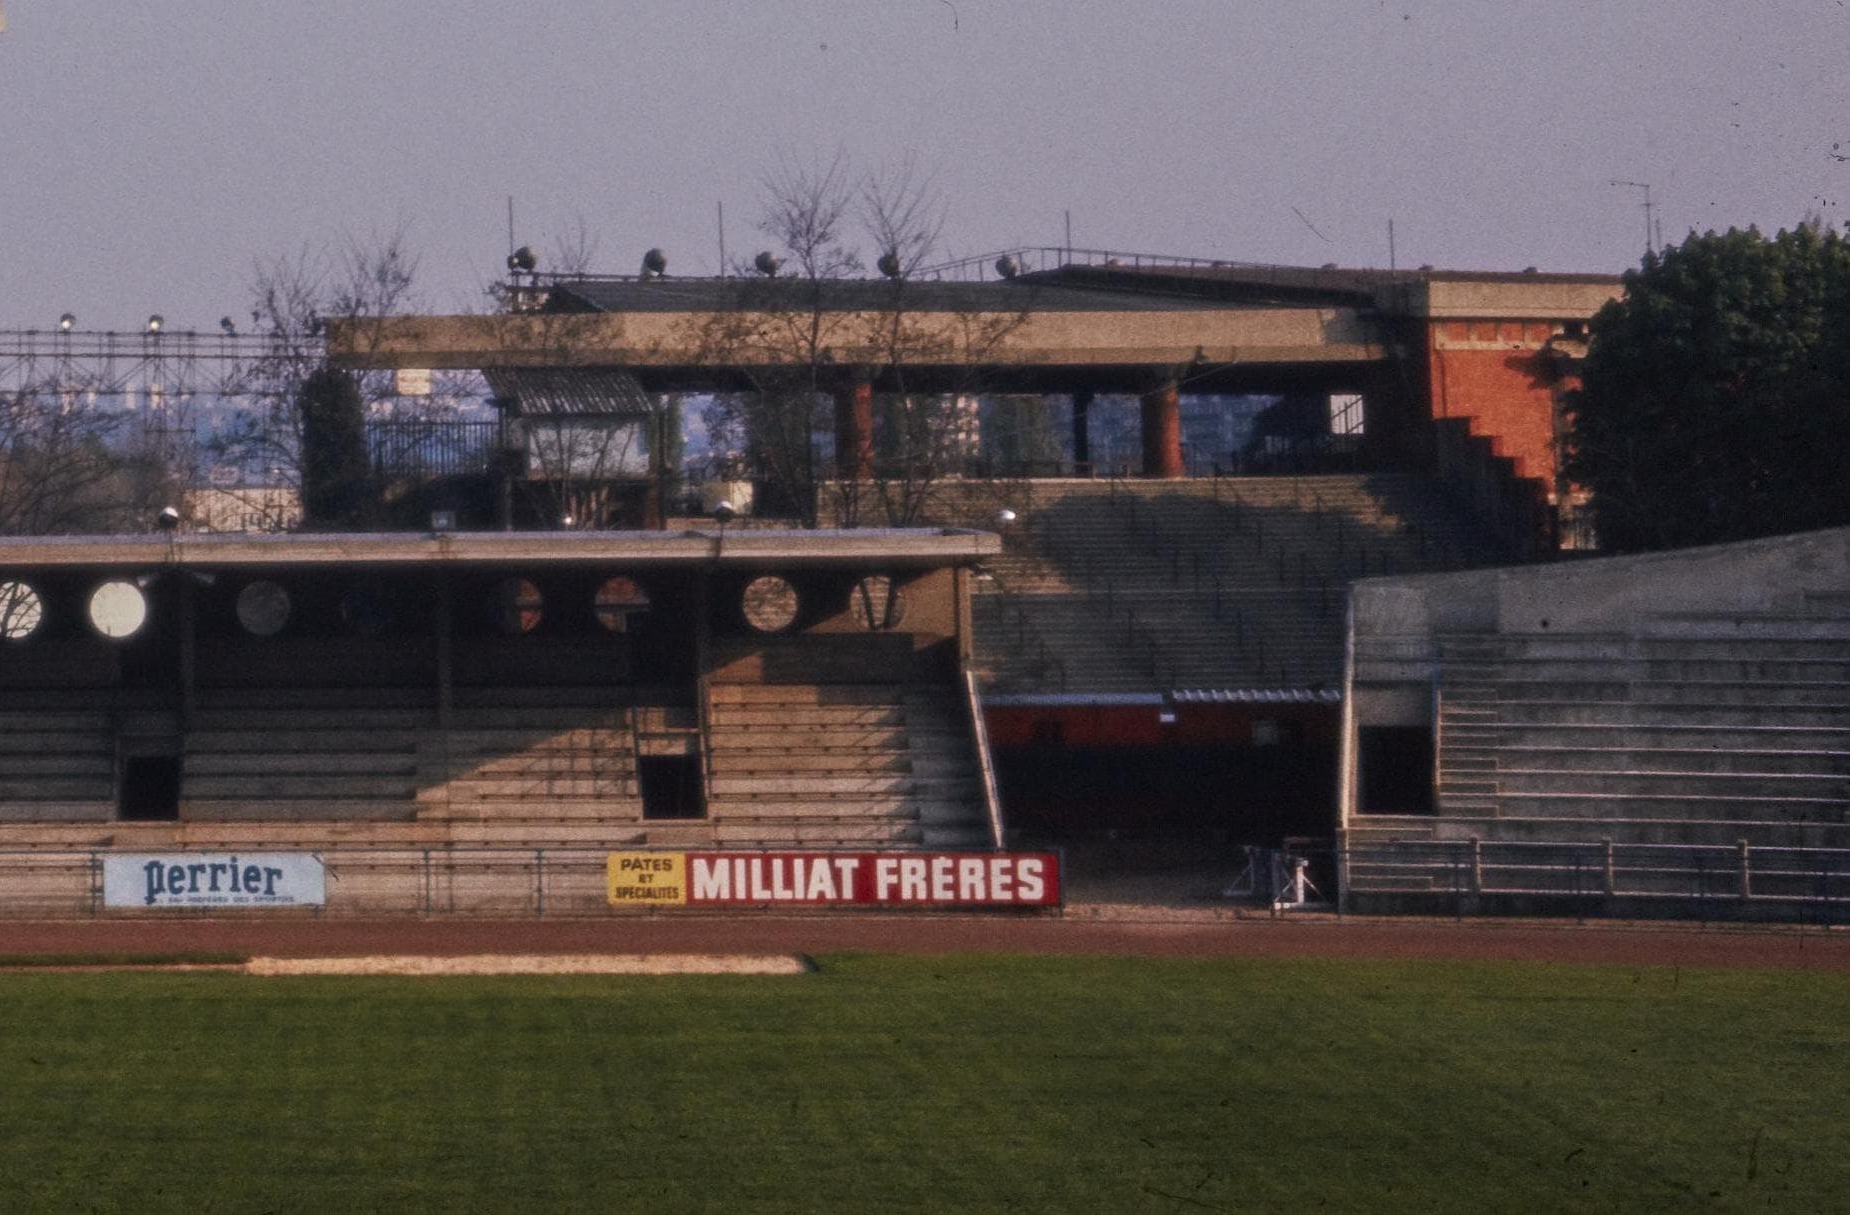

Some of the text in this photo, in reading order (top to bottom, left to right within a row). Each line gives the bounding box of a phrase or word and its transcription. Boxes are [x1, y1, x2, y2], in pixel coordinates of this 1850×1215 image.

[144, 856, 283, 905] perrier
[638, 873, 655, 884] ET
[692, 858, 859, 900] MILLIAT
